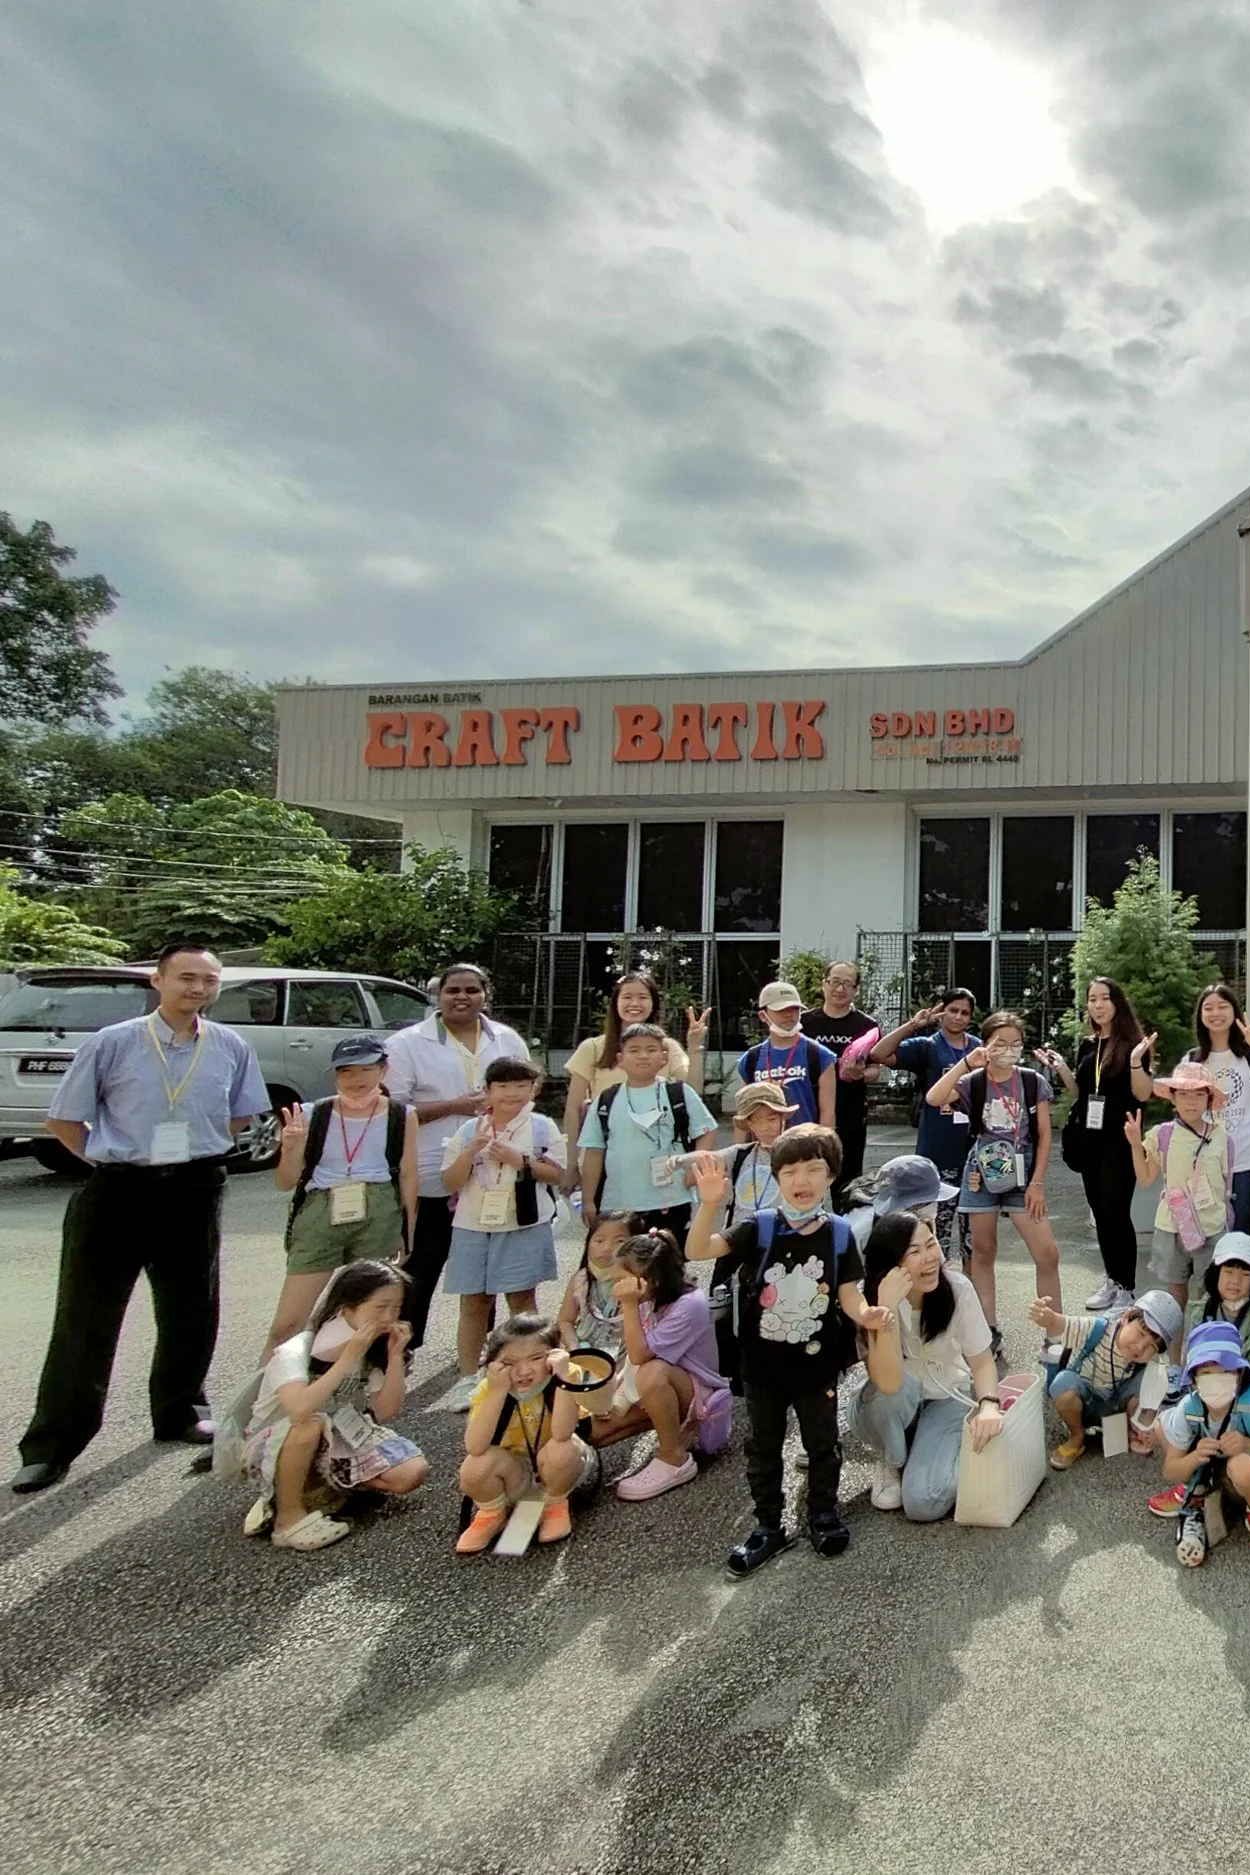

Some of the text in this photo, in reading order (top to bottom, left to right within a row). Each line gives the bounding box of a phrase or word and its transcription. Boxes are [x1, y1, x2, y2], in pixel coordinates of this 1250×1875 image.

[368, 691, 482, 705] BARANGAN BATIK
[870, 707, 1014, 738] SDN BHD
[363, 700, 825, 768] CRAFT BATIK
[944, 756, 979, 764] PERMIT
